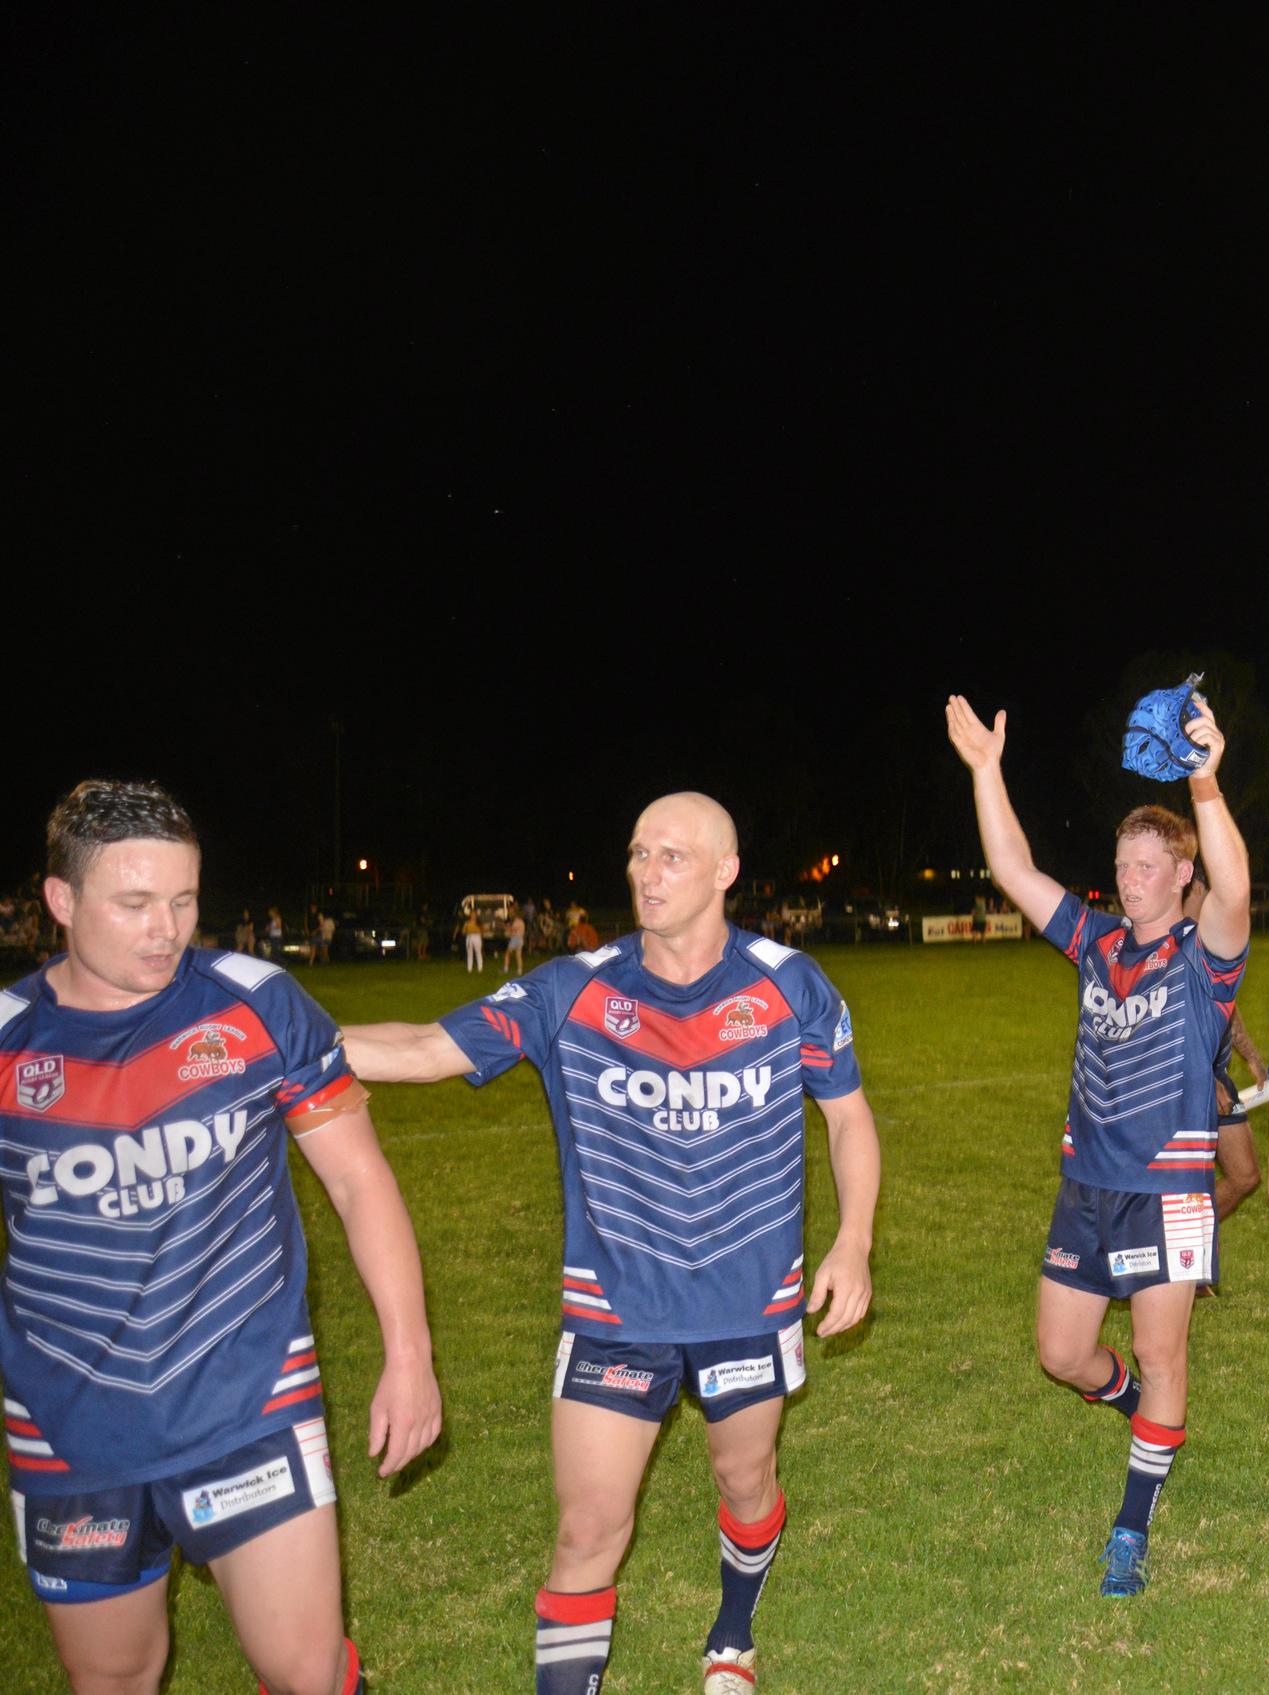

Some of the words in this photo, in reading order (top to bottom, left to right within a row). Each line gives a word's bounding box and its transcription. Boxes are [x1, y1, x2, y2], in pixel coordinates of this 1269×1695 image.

[610, 1000, 633, 1012] QLD
[719, 1025, 768, 1041] COWBOYS
[23, 1060, 57, 1078] QLD
[178, 1058, 247, 1081] COWBOYS
[596, 1065, 772, 1110] CONDY
[652, 1110, 720, 1131] CLUB
[26, 1109, 248, 1206] CONDY
[98, 1175, 187, 1219] CLUB
[576, 1361, 654, 1381] Checkmate
[718, 1364, 756, 1376] Warwick
[757, 1361, 772, 1370] Ice
[602, 1375, 652, 1392] Safety
[212, 1474, 264, 1499] Warwick
[266, 1465, 287, 1480] Ice
[220, 1483, 277, 1511] Distributors
